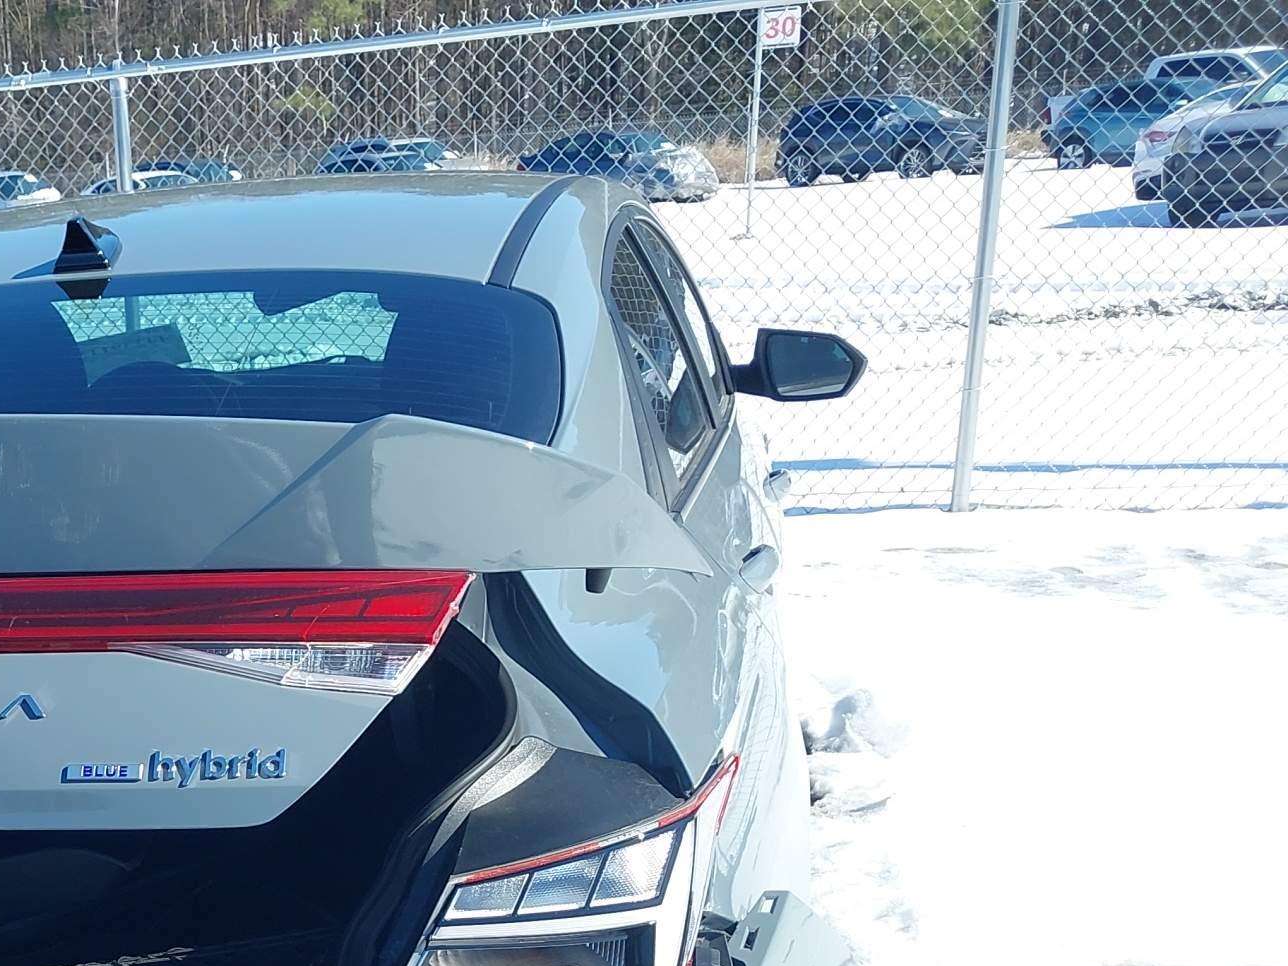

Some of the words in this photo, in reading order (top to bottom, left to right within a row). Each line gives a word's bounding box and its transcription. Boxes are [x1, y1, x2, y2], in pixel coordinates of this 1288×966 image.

[765, 16, 797, 39] 30
[80, 765, 129, 778] BLUE
[147, 747, 287, 789] hybrid
